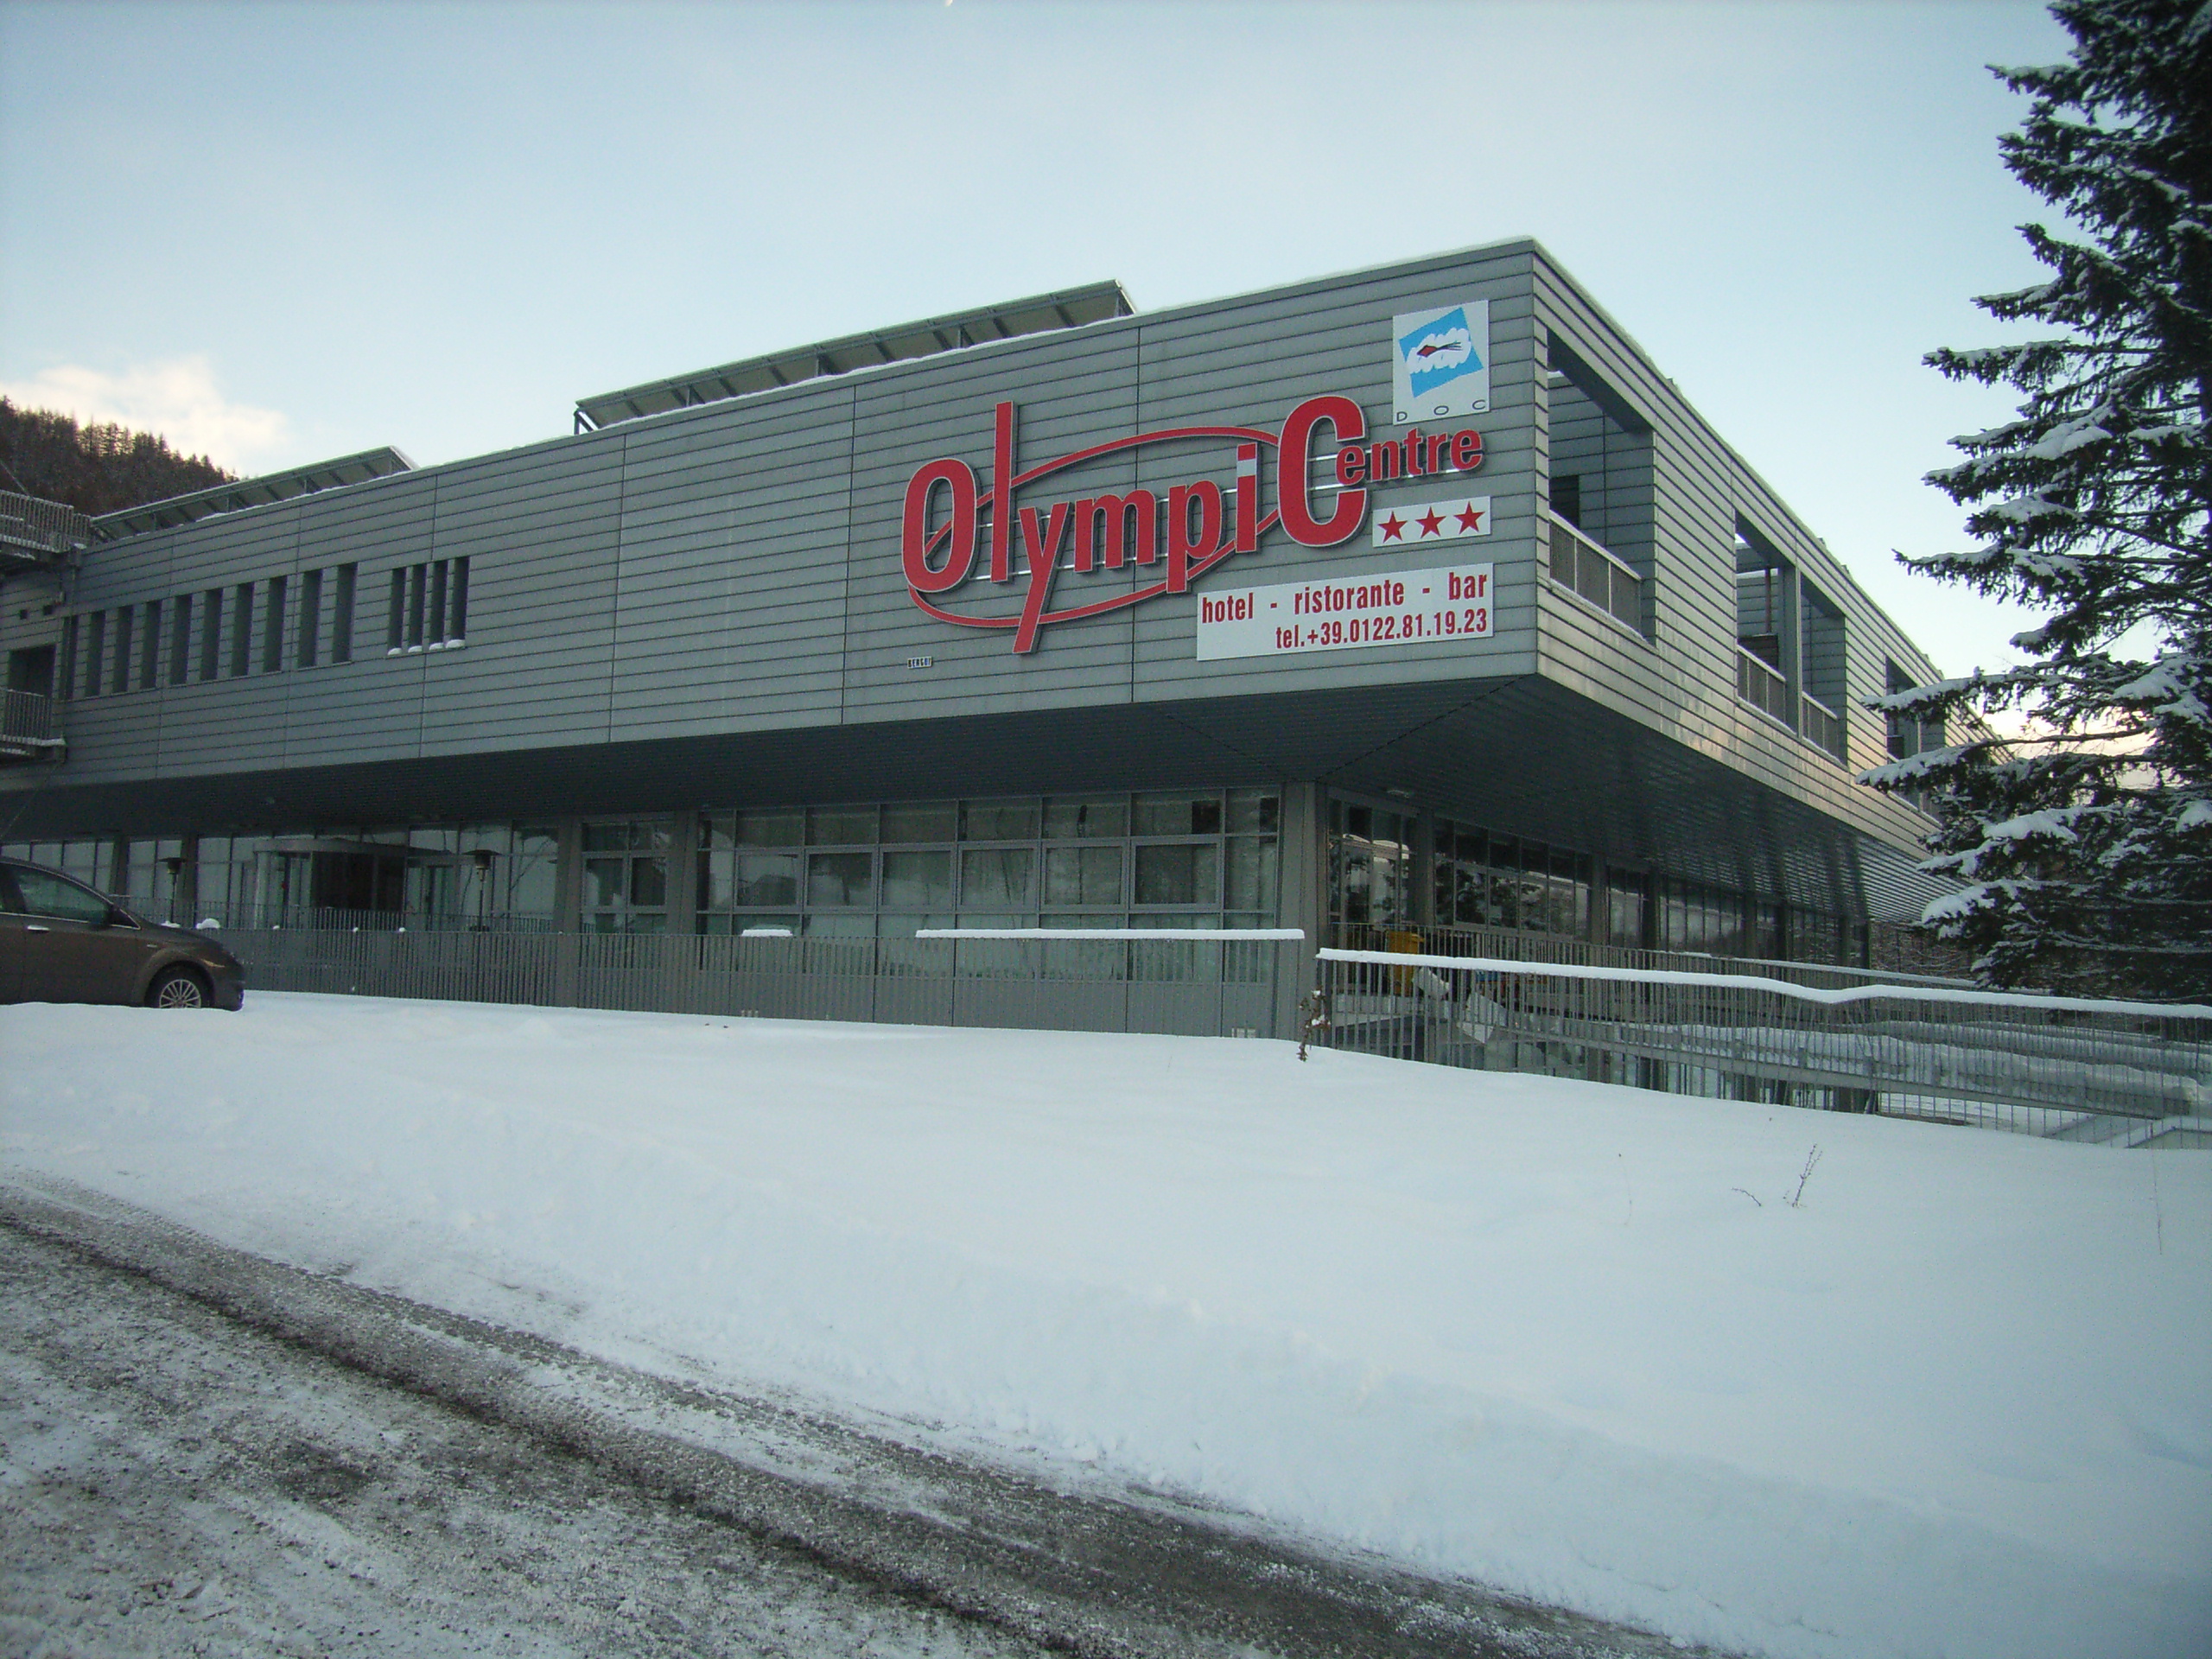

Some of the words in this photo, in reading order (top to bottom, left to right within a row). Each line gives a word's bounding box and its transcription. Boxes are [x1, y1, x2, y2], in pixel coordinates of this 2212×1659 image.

[1201, 593, 1254, 624] hotel
[1294, 580, 1405, 615] ristorante
[1448, 572, 1488, 601] bar
